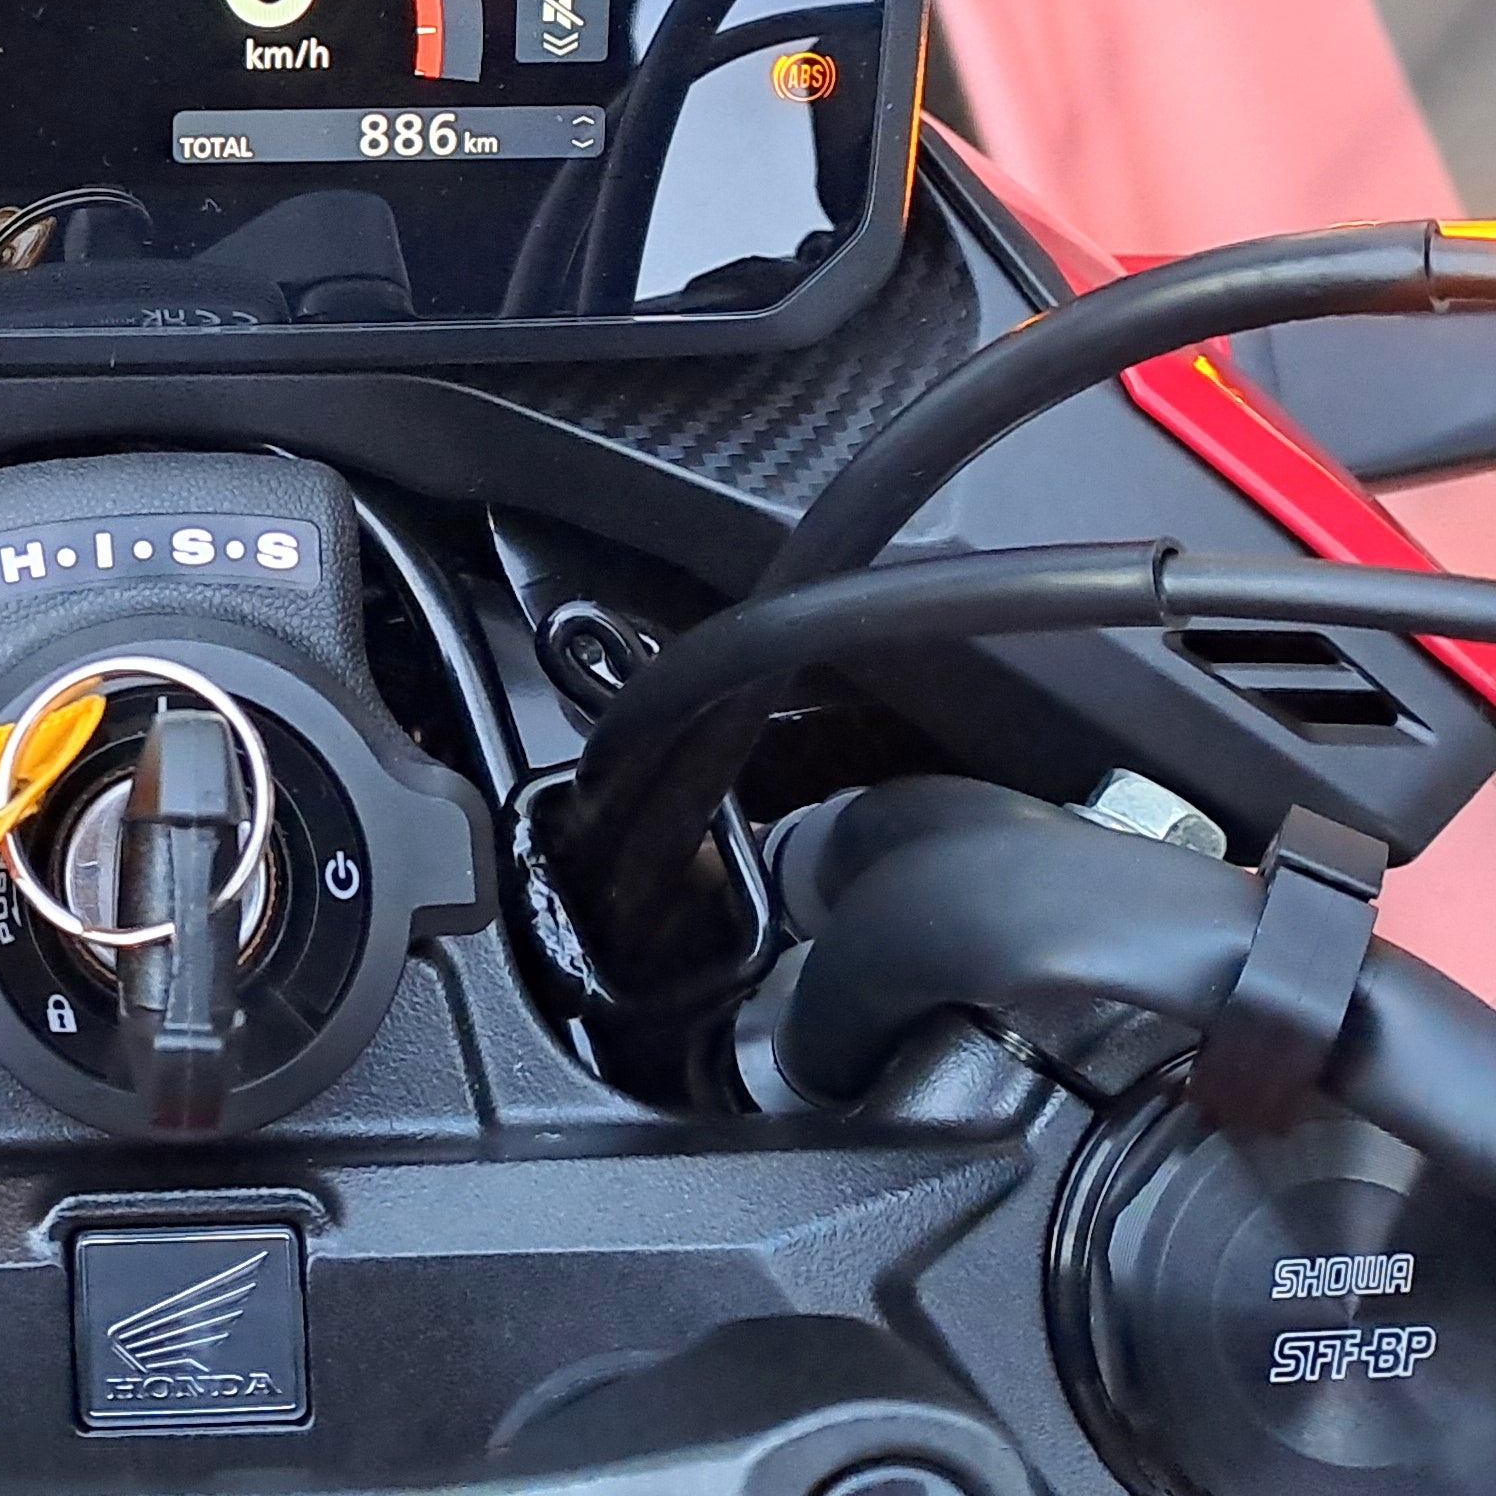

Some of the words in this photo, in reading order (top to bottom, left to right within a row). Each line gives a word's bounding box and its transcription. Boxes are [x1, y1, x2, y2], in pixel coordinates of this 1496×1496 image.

[245, 37, 331, 70] km/h
[788, 64, 824, 88] ABS
[180, 137, 254, 159] TOTAL
[359, 112, 458, 157] 886
[463, 131, 499, 154] km
[1271, 1253, 1415, 1298] SHOWA
[1269, 1326, 1437, 1383] SFF-BP
[106, 1372, 283, 1400] HONDA
